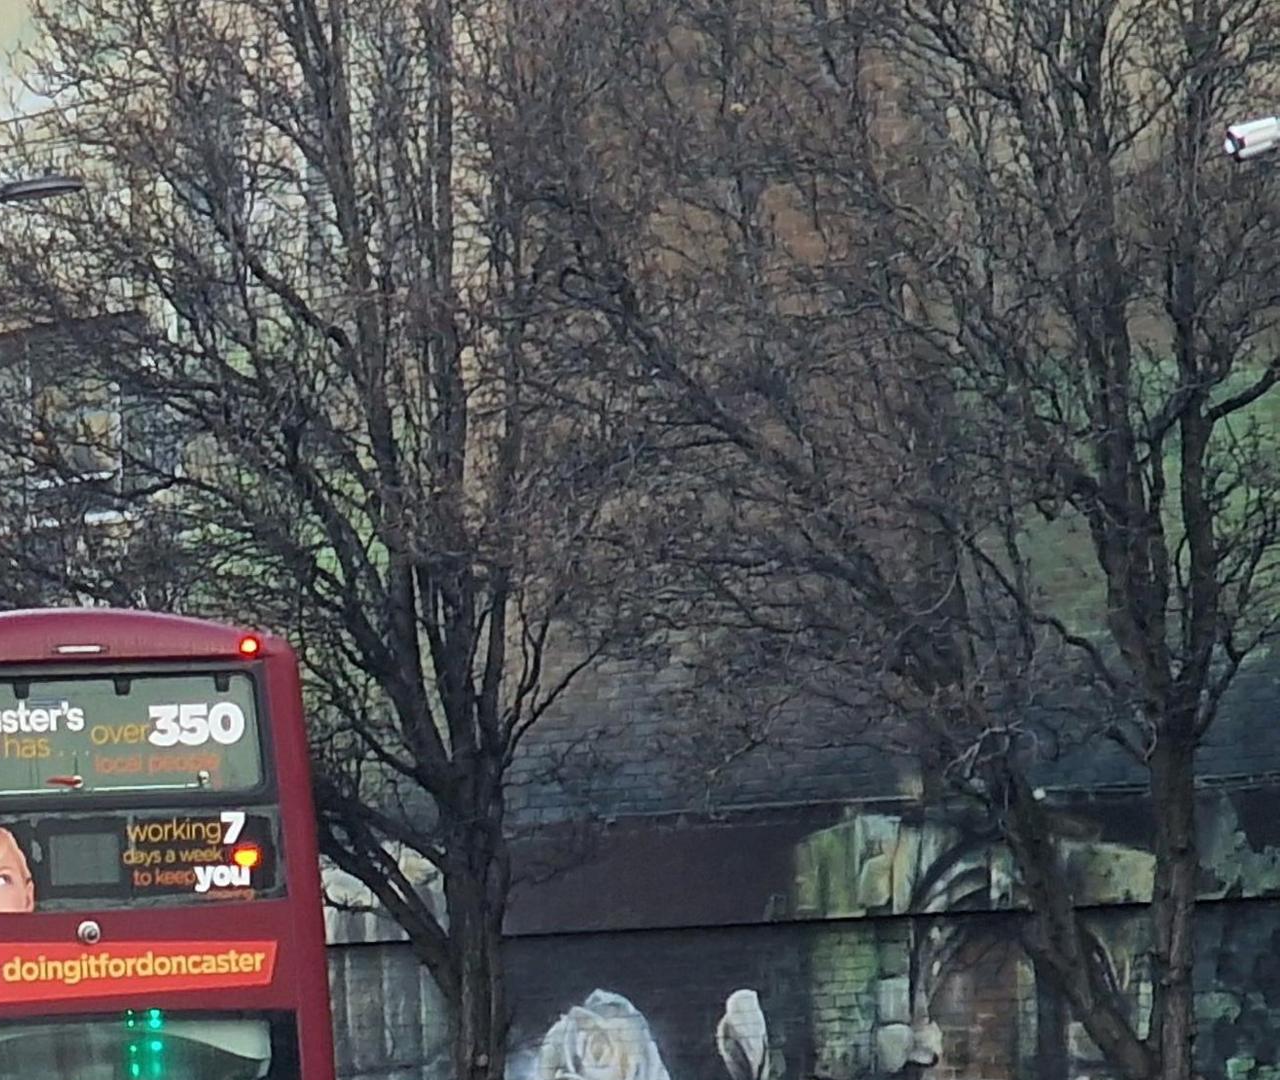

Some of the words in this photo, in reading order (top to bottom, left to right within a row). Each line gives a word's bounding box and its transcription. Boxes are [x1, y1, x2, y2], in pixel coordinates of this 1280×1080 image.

[91, 723, 151, 745] over
[148, 702, 245, 747] 350
[127, 817, 222, 845] working
[220, 811, 246, 845] 7
[123, 847, 161, 866] days
[165, 849, 176, 863] a
[180, 846, 223, 862] week
[133, 868, 152, 886] to
[155, 868, 196, 886] keep
[193, 865, 251, 892] you
